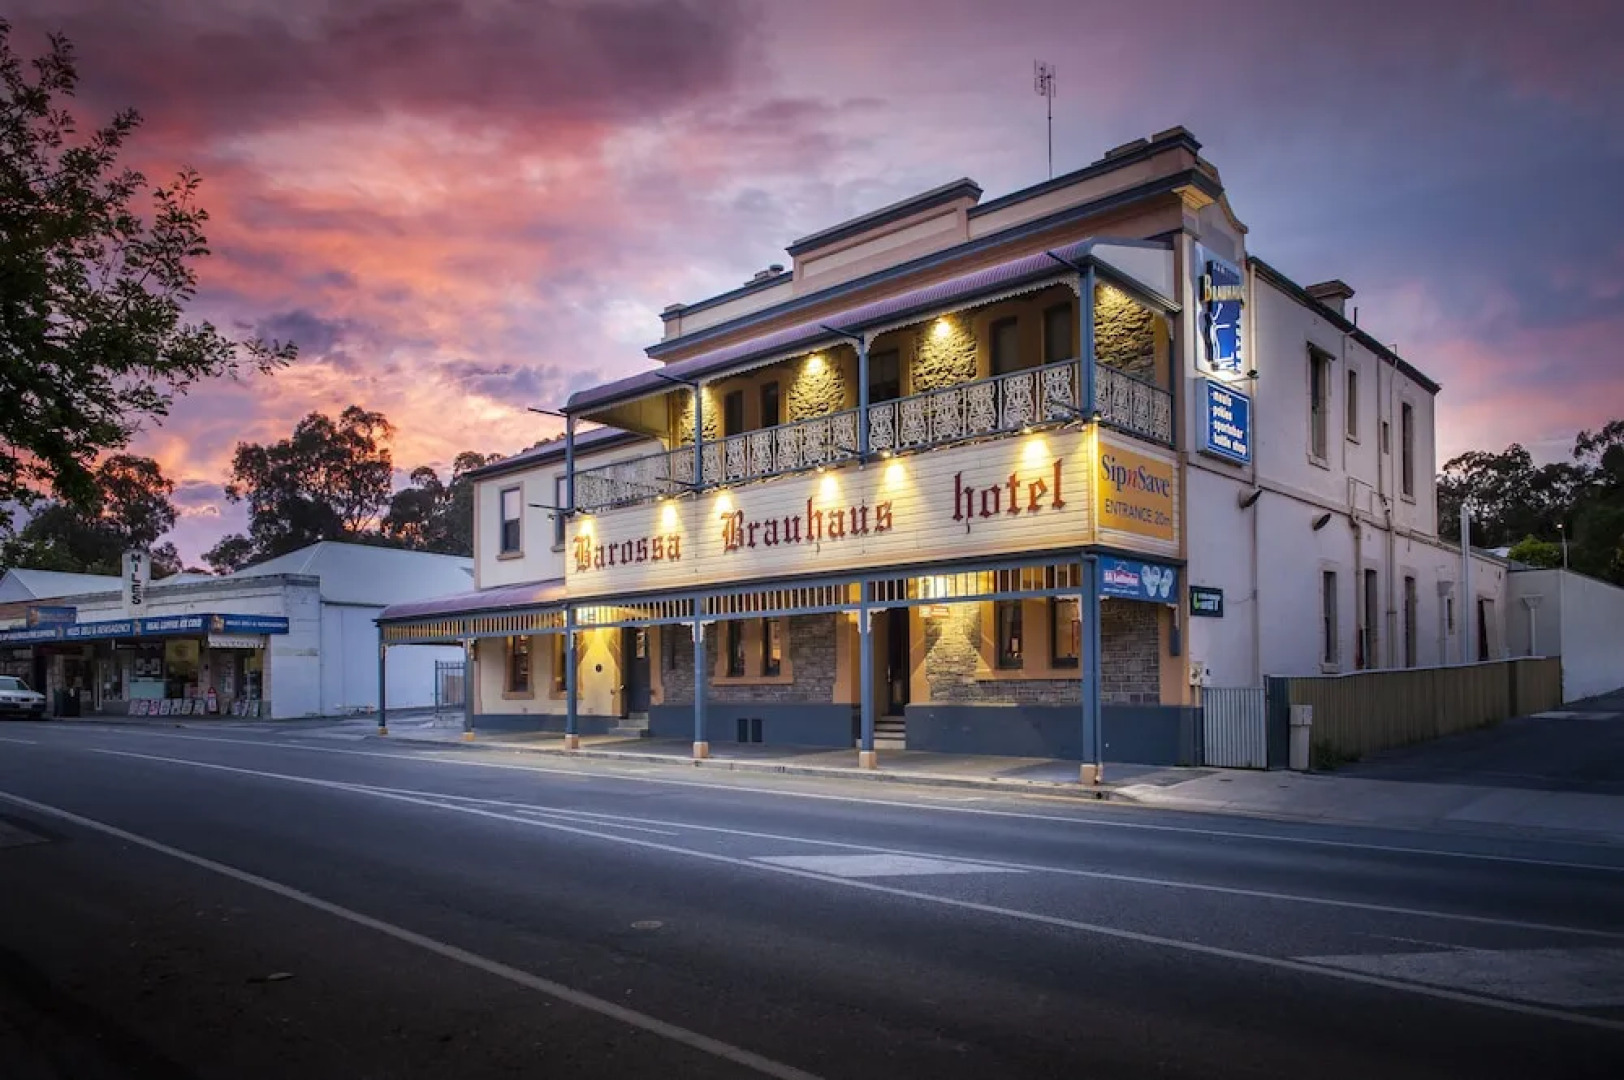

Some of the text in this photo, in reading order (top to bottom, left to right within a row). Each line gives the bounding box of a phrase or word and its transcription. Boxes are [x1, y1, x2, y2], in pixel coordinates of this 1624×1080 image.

[573, 458, 1067, 572] Barossa Brauhaus hotel
[1105, 499, 1152, 523] ENTRANCE
[131, 554, 141, 604] MILES
